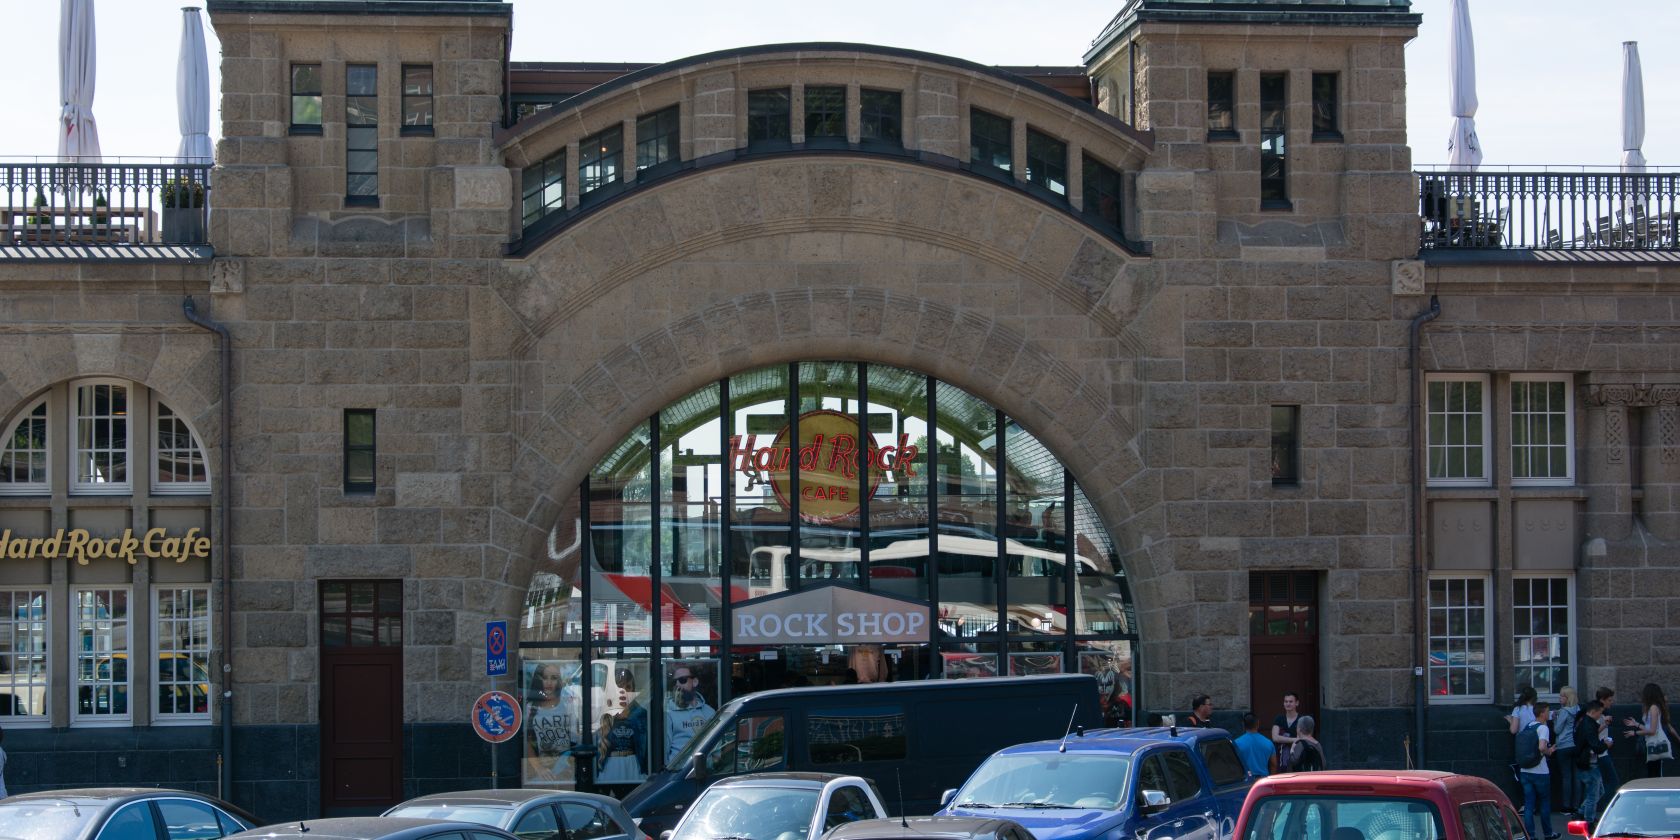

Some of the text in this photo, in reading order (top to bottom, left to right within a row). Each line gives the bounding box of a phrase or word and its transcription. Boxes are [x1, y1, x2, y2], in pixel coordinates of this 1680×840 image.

[729, 434, 919, 480] Hard Rock
[803, 486, 849, 501] CAFE
[67, 528, 139, 566] Rock
[143, 527, 211, 563] Cafe
[737, 612, 925, 638] ROCK SHOP
